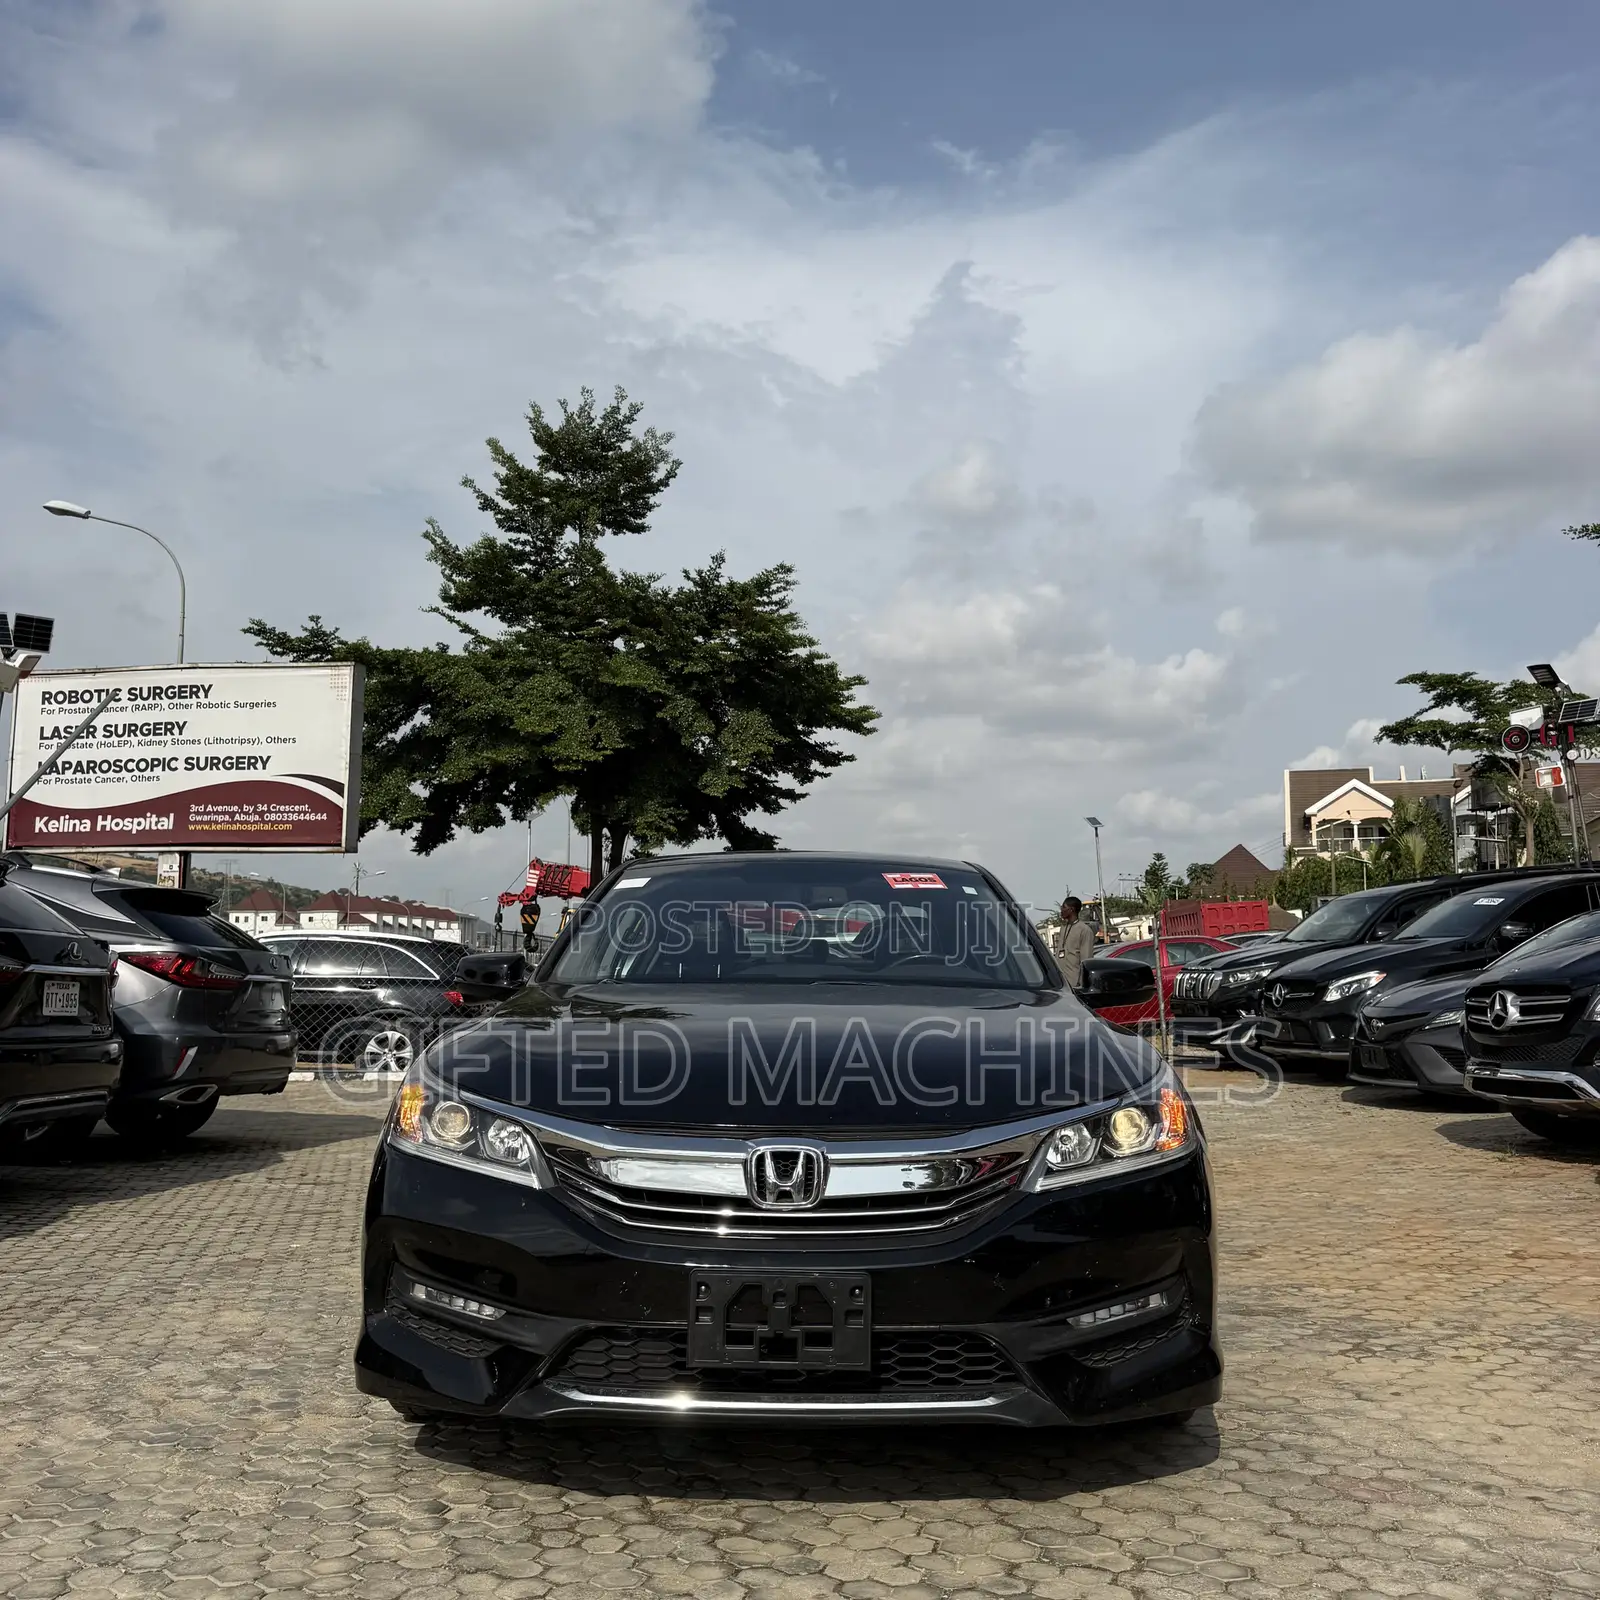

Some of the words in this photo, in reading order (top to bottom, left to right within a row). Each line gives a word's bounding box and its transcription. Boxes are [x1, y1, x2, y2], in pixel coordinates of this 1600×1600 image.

[127, 684, 213, 702] SURGERY
[40, 707, 56, 715] For
[99, 705, 129, 714] ancer
[131, 702, 165, 713] (RARP),
[168, 702, 193, 710] Other
[196, 700, 231, 710] Robotic
[233, 699, 277, 710] Surgeries
[102, 721, 188, 739] SURGERY
[38, 742, 54, 751] For
[96, 739, 135, 750] (HoLEP),
[137, 738, 169, 748] Kidney
[170, 737, 202, 746] Stones
[203, 736, 263, 747] (Lithotripsy),
[265, 735, 297, 744] Others
[183, 755, 272, 772] SURGERY
[37, 777, 53, 785] For
[55, 776, 93, 785] Prostate
[95, 775, 128, 784] Cancer,
[130, 774, 161, 783] Others
[189, 804, 205, 813] 3rd
[206, 804, 241, 814] Avenue,
[243, 803, 254, 815] by
[256, 803, 268, 812] 34
[270, 803, 311, 813] Crescent,
[35, 814, 91, 834] Kelina
[96, 812, 175, 835] Hospital
[188, 813, 232, 823] Gwarinpa,
[264, 812, 327, 821] 08033644644
[188, 822, 293, 832] www.kelinahospital.com
[56, 982, 71, 990] TEXAS
